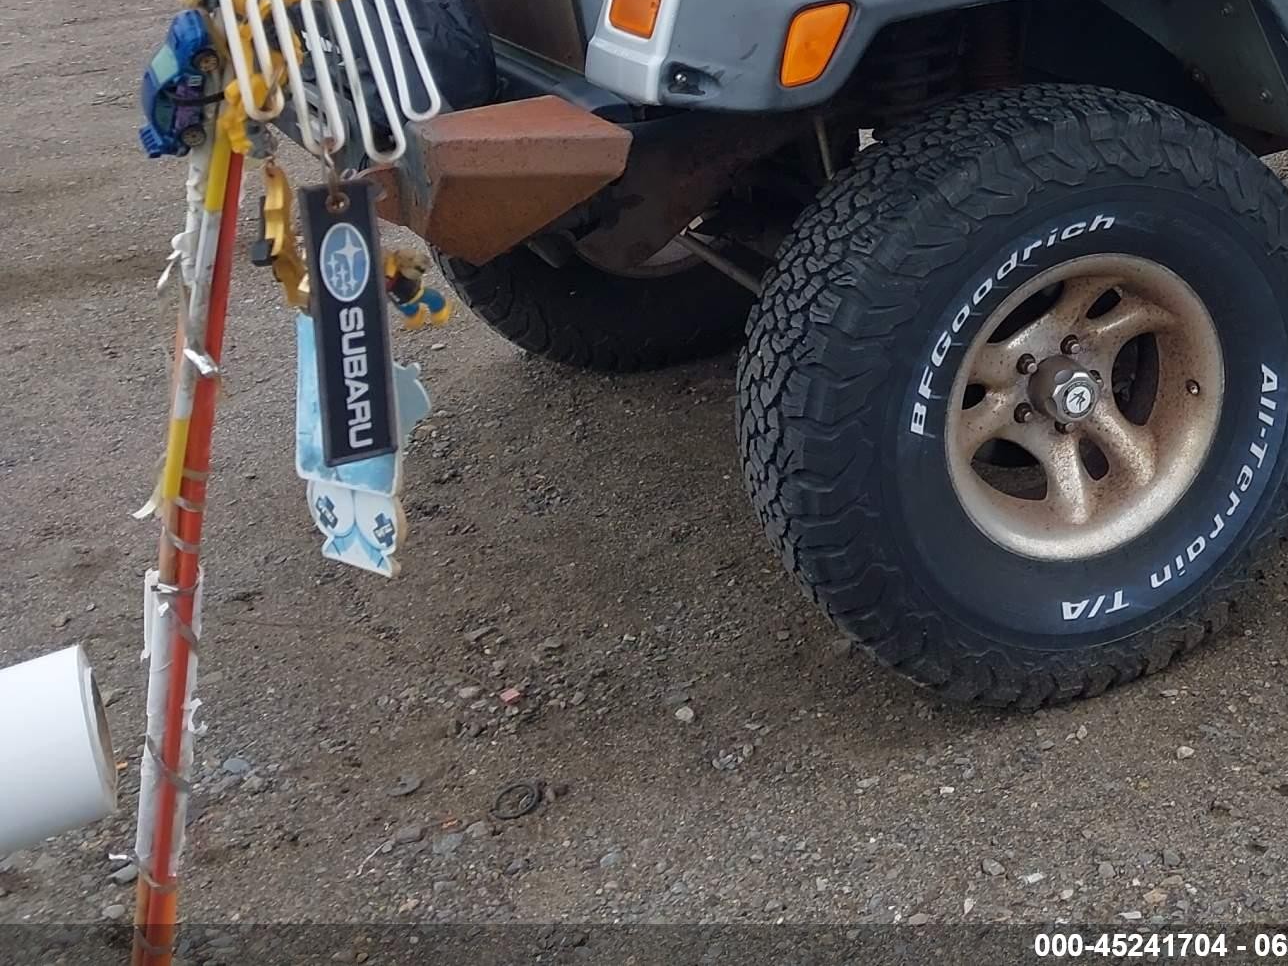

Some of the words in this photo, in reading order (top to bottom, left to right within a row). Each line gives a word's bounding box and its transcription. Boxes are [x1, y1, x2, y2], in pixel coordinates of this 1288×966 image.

[339, 306, 374, 449] SUBARU
[909, 213, 1117, 436] BFGoodrich
[1149, 363, 1280, 589] All-Terrain
[1061, 589, 1130, 621] T/A
